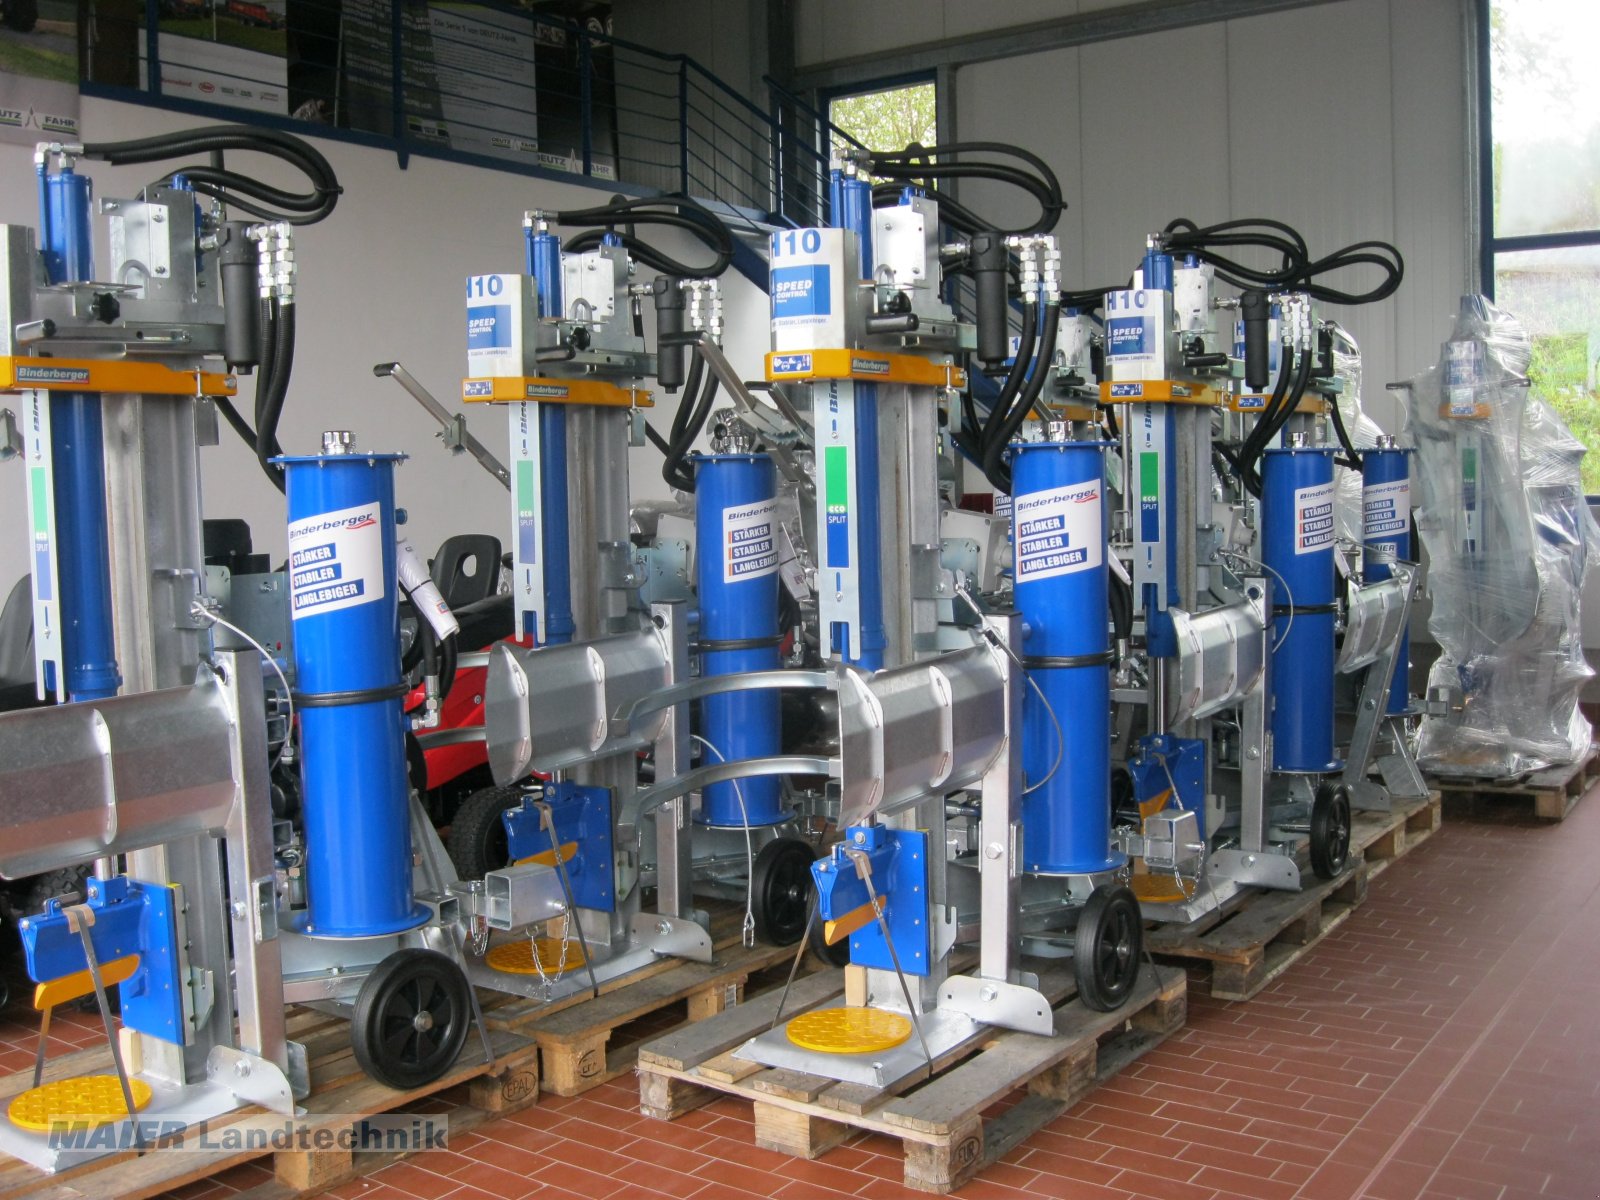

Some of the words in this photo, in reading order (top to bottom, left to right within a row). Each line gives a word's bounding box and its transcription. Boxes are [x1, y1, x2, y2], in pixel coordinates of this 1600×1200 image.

[45, 116, 75, 127] FAHR
[491, 137, 510, 145] DEUTZ
[591, 165, 609, 175] AHR
[776, 280, 812, 292] SPEED
[776, 290, 808, 299] CONTROL
[468, 317, 496, 328] SPEED
[468, 326, 492, 334] CONTROL
[1113, 327, 1143, 336] SPEED
[853, 359, 890, 372] Binderberger
[18, 367, 88, 380] Binderberger
[527, 385, 568, 395] Binderberger
[1018, 489, 1096, 511] Binderberger
[828, 505, 846, 513] eco
[1304, 504, 1331, 518] STÄRKER
[290, 513, 373, 539] Binderberger
[520, 519, 533, 527] SPLIT
[828, 515, 846, 524] SPLIT
[1304, 518, 1332, 532] STABILER
[734, 525, 768, 541] STÄRKER
[1021, 517, 1061, 536] STÄRKER
[36, 543, 48, 552] SPLIT
[734, 541, 770, 557] STABILER
[1022, 536, 1064, 554] STABILER
[293, 546, 332, 566] STÄRKER
[1022, 551, 1083, 573] LANGLEBIGER
[294, 567, 335, 587] STABILER
[295, 583, 358, 607] LANGLEBIGER
[507, 1077, 529, 1098] EPAL
[958, 1140, 975, 1163] EUR
